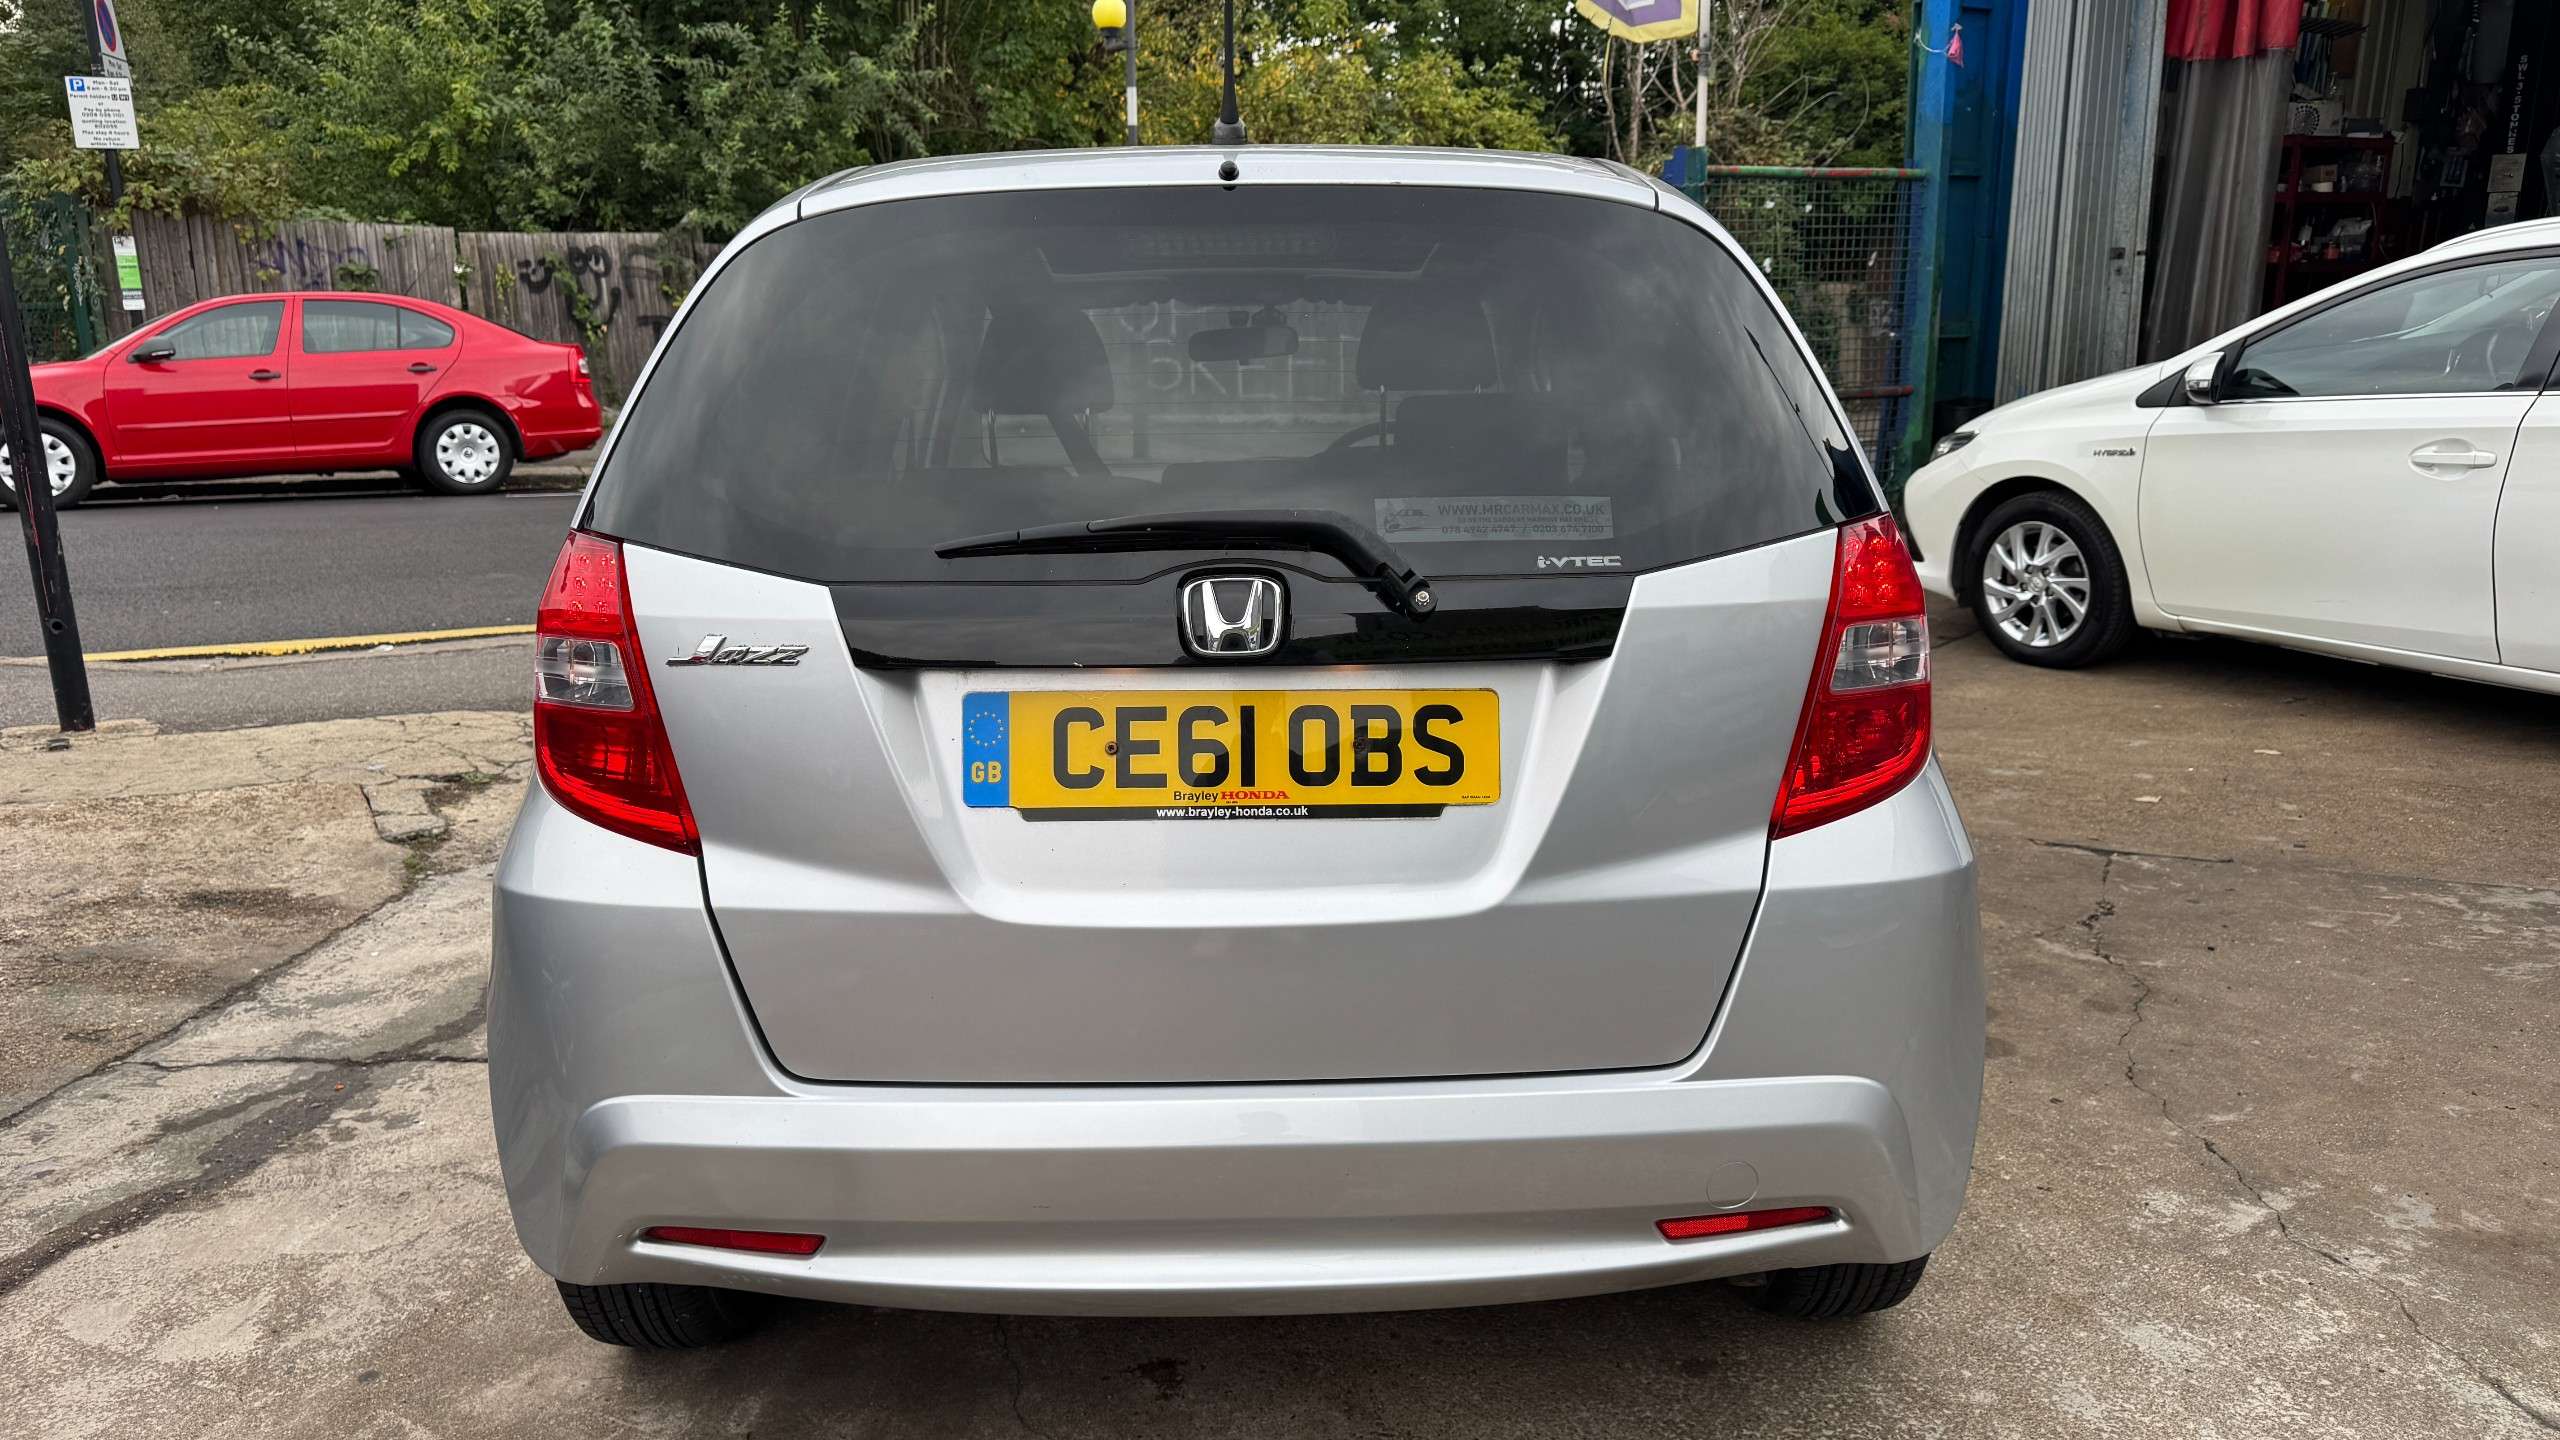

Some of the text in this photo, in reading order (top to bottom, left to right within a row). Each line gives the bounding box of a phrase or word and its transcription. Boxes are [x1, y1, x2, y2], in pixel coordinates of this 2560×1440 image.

[1438, 503, 1605, 516] WWW.MRCARMAX.CO.UK
[665, 633, 811, 667] Jazz
[1052, 704, 1466, 789] CE61 OBS
[970, 761, 1002, 783] GB
[1173, 790, 1219, 803] Brayley
[1221, 790, 1290, 800] HONDA
[1156, 805, 1310, 819] www.brayley-honda.co.uk
